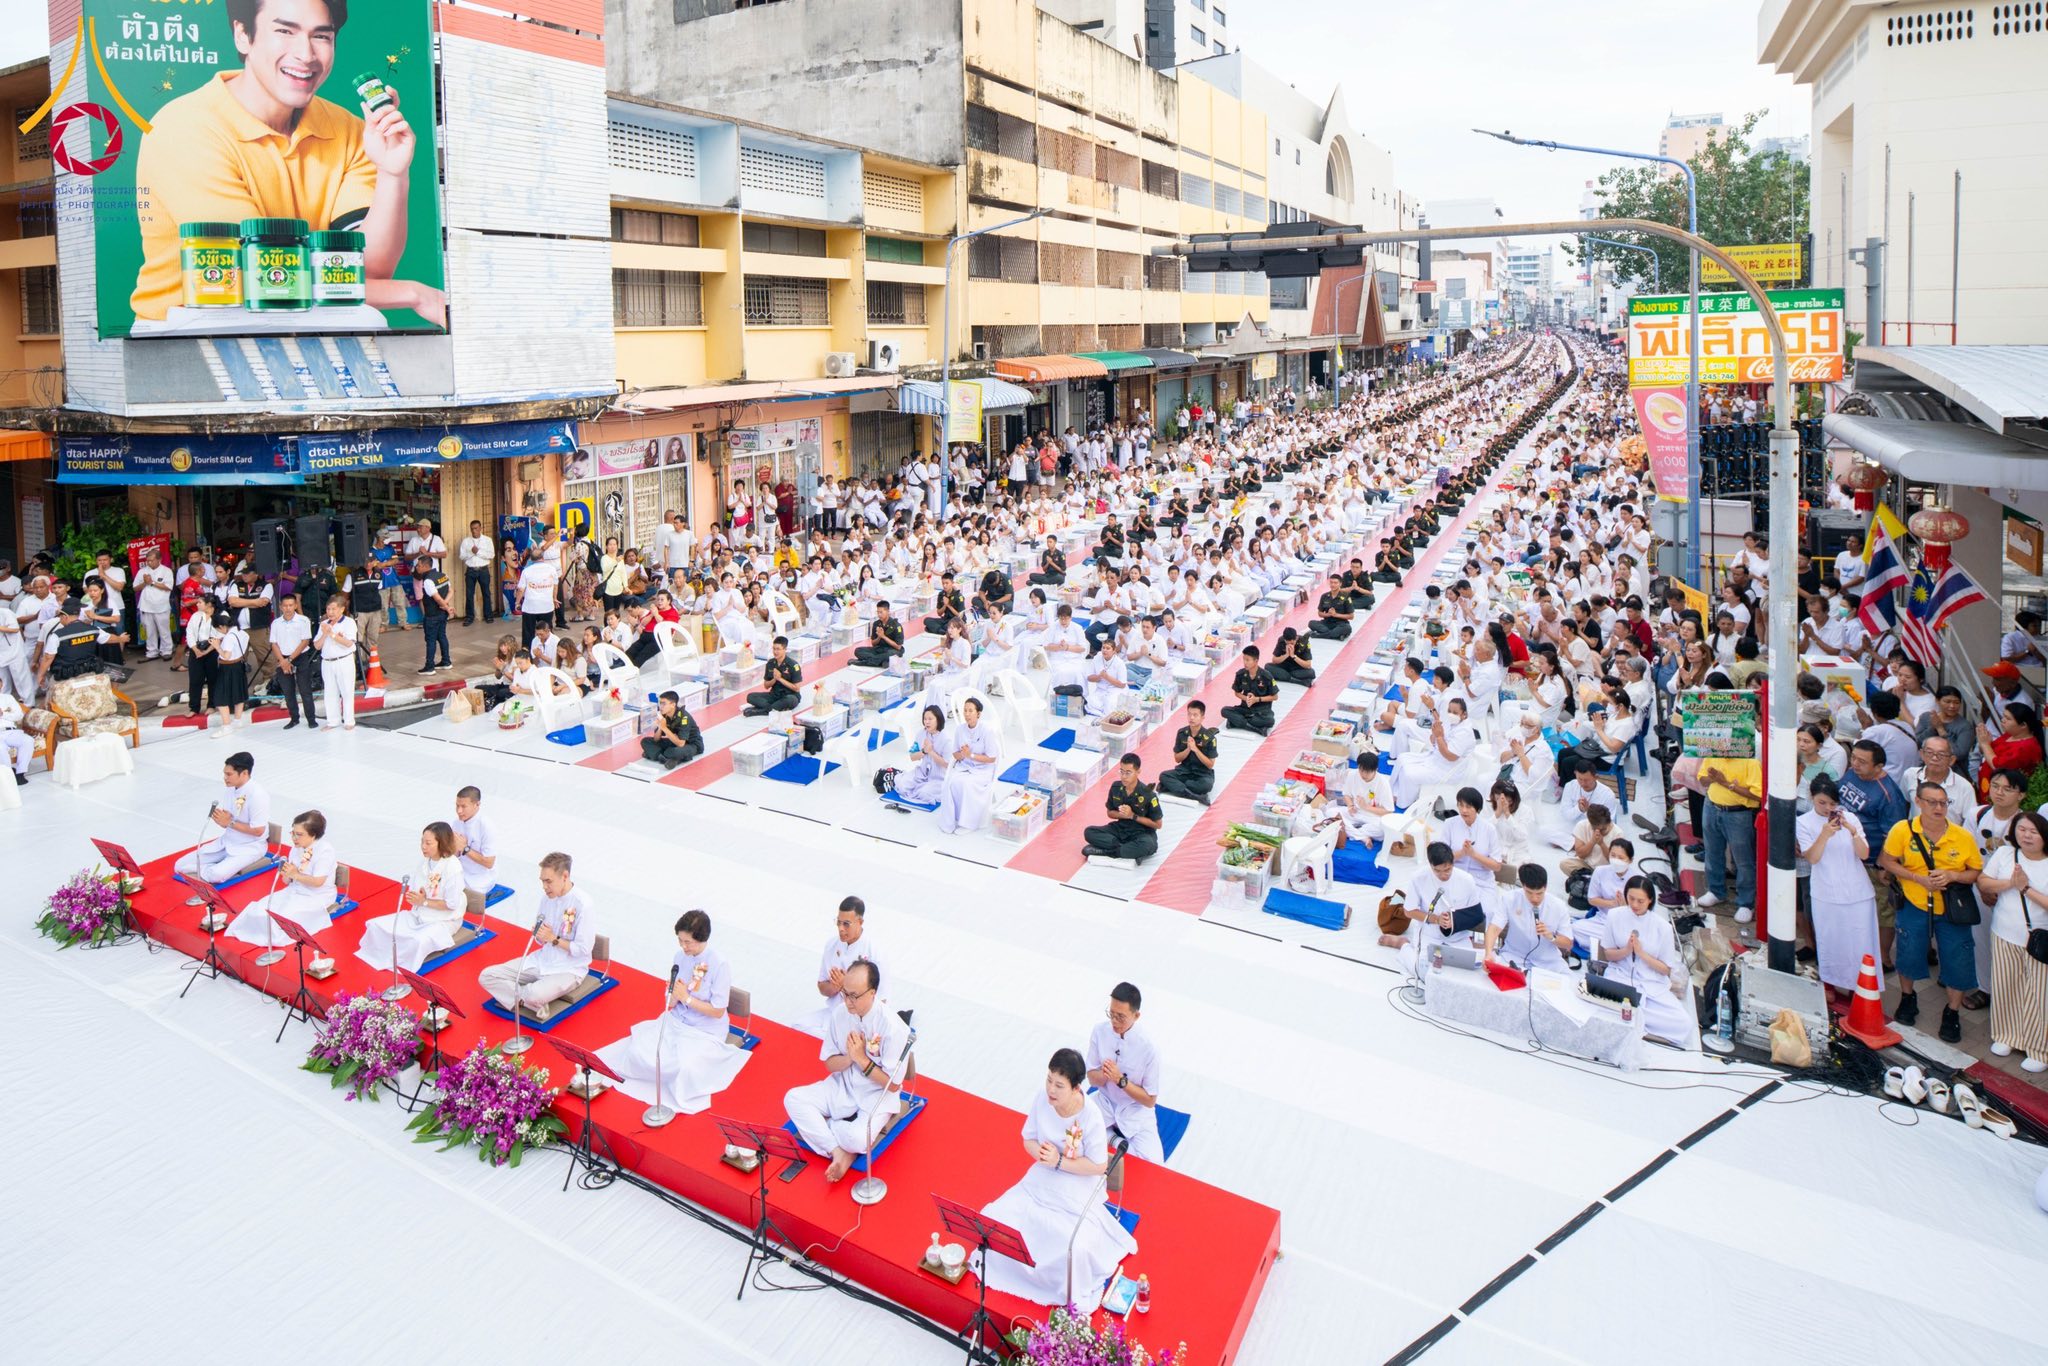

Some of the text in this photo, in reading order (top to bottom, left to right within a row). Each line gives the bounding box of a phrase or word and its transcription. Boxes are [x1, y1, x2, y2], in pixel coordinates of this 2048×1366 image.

[308, 442, 382, 457] dtac HAPPY
[395, 445, 438, 455] Thailand's
[464, 441, 492, 450] Tourist
[493, 440, 508, 449] SIM
[510, 439, 528, 448] Card
[66, 448, 123, 459] dtac HAPPY
[66, 461, 124, 470] TOURIST SIM
[133, 456, 171, 464] Thailand's
[193, 456, 219, 464] Tourist
[220, 456, 234, 464] SIM
[235, 456, 253, 464] Card
[309, 454, 383, 469] TOURIST SIM
[71, 634, 95, 646] EAGLE
